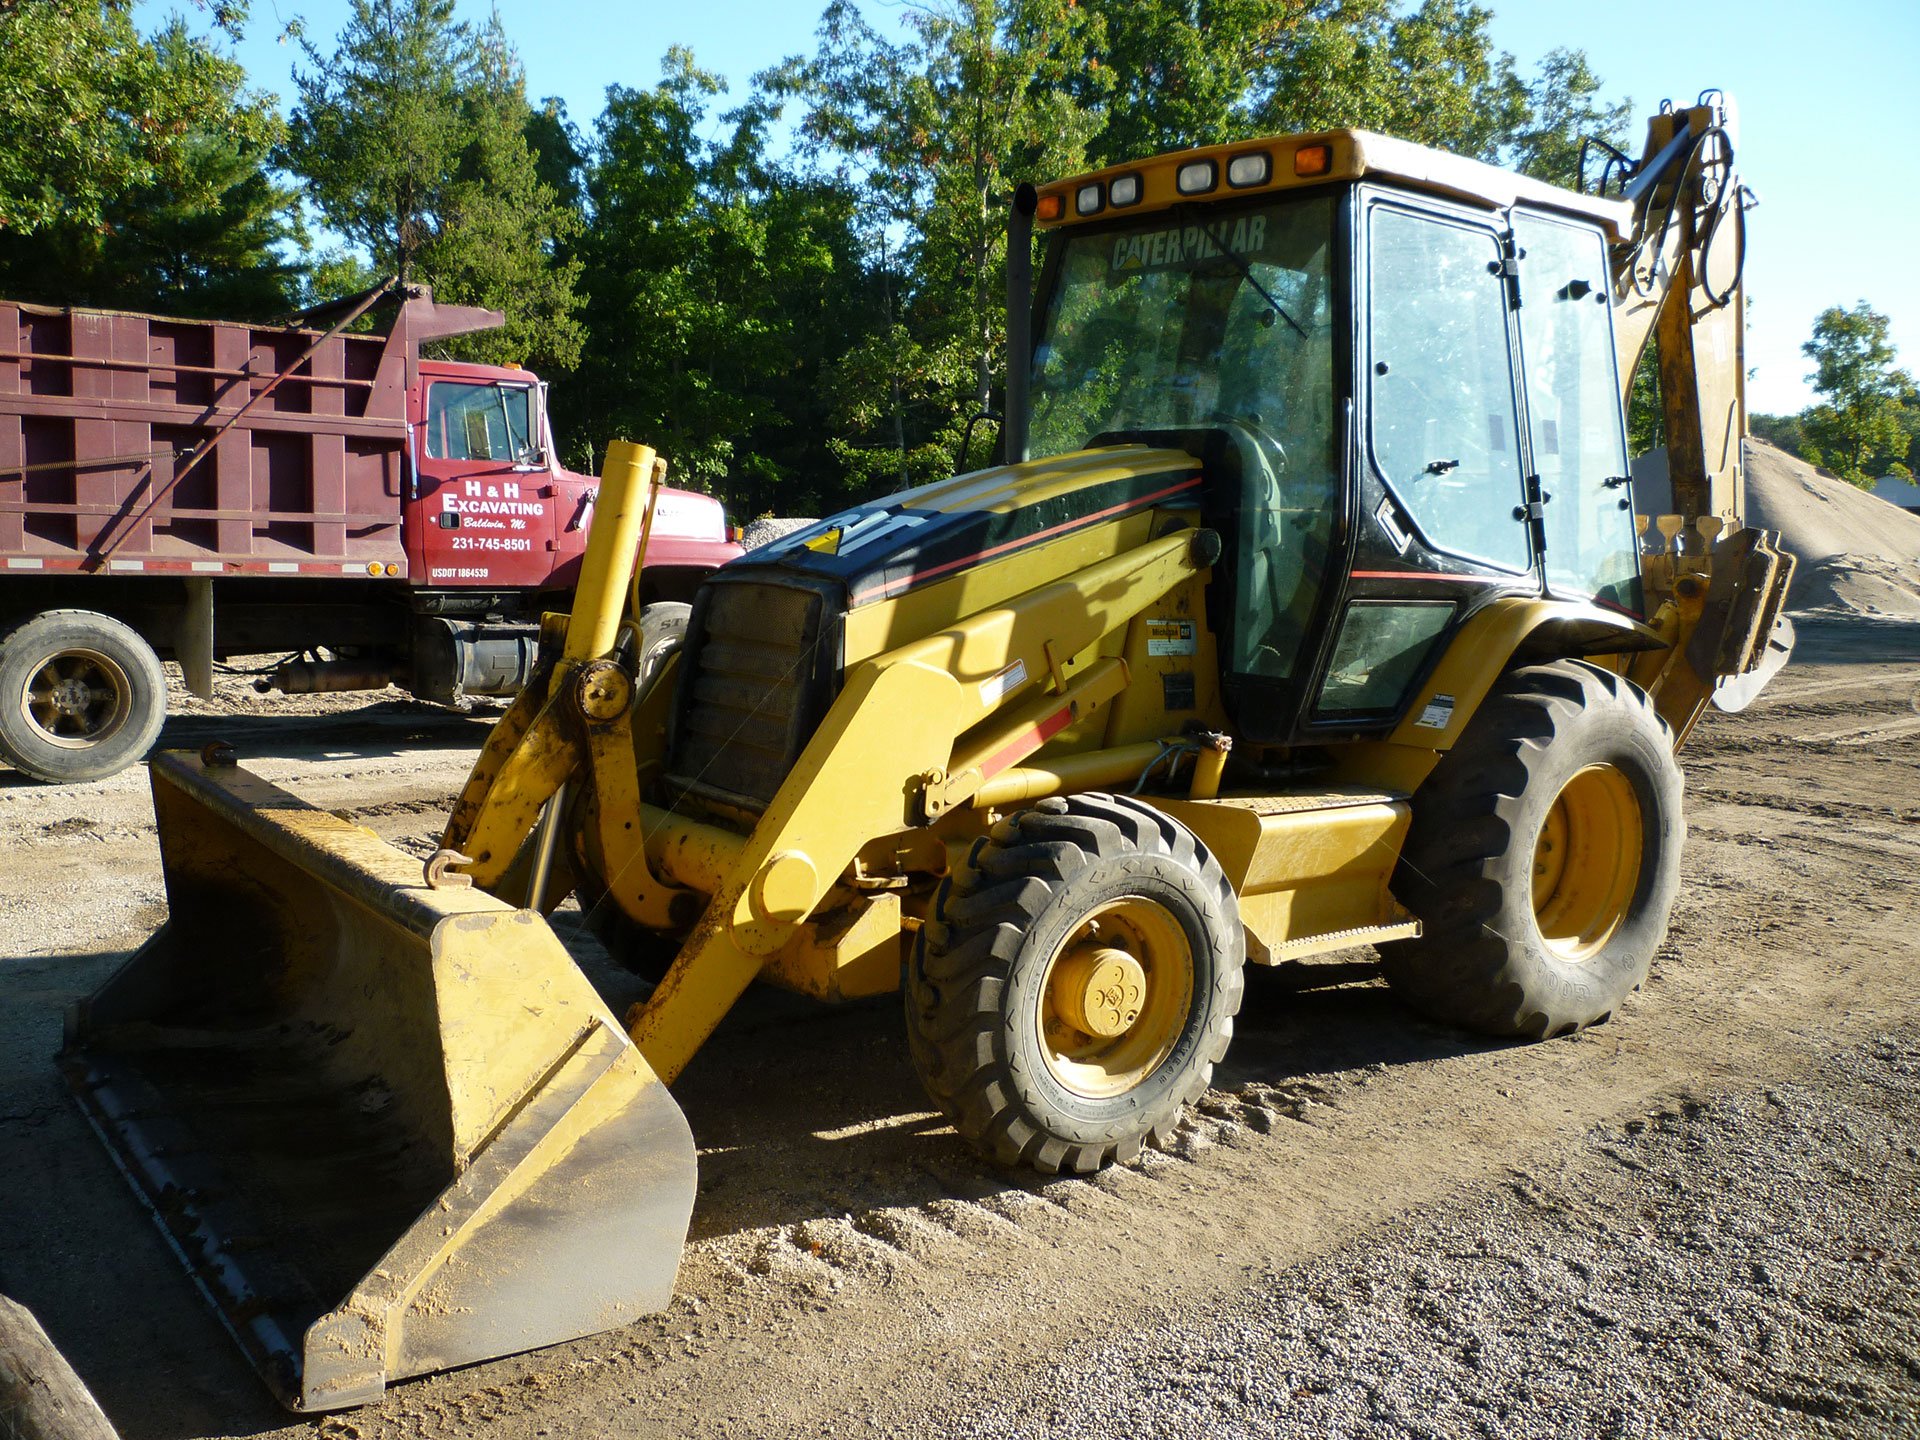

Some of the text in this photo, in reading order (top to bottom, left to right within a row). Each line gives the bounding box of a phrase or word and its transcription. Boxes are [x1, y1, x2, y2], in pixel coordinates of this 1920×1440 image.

[1112, 215, 1267, 271] CATERPILLAR
[465, 480, 519, 499] H & H
[442, 493, 543, 515] EXCAVATING
[452, 537, 531, 551] 231-745-8501
[432, 568, 489, 578] USDOT 1864539
